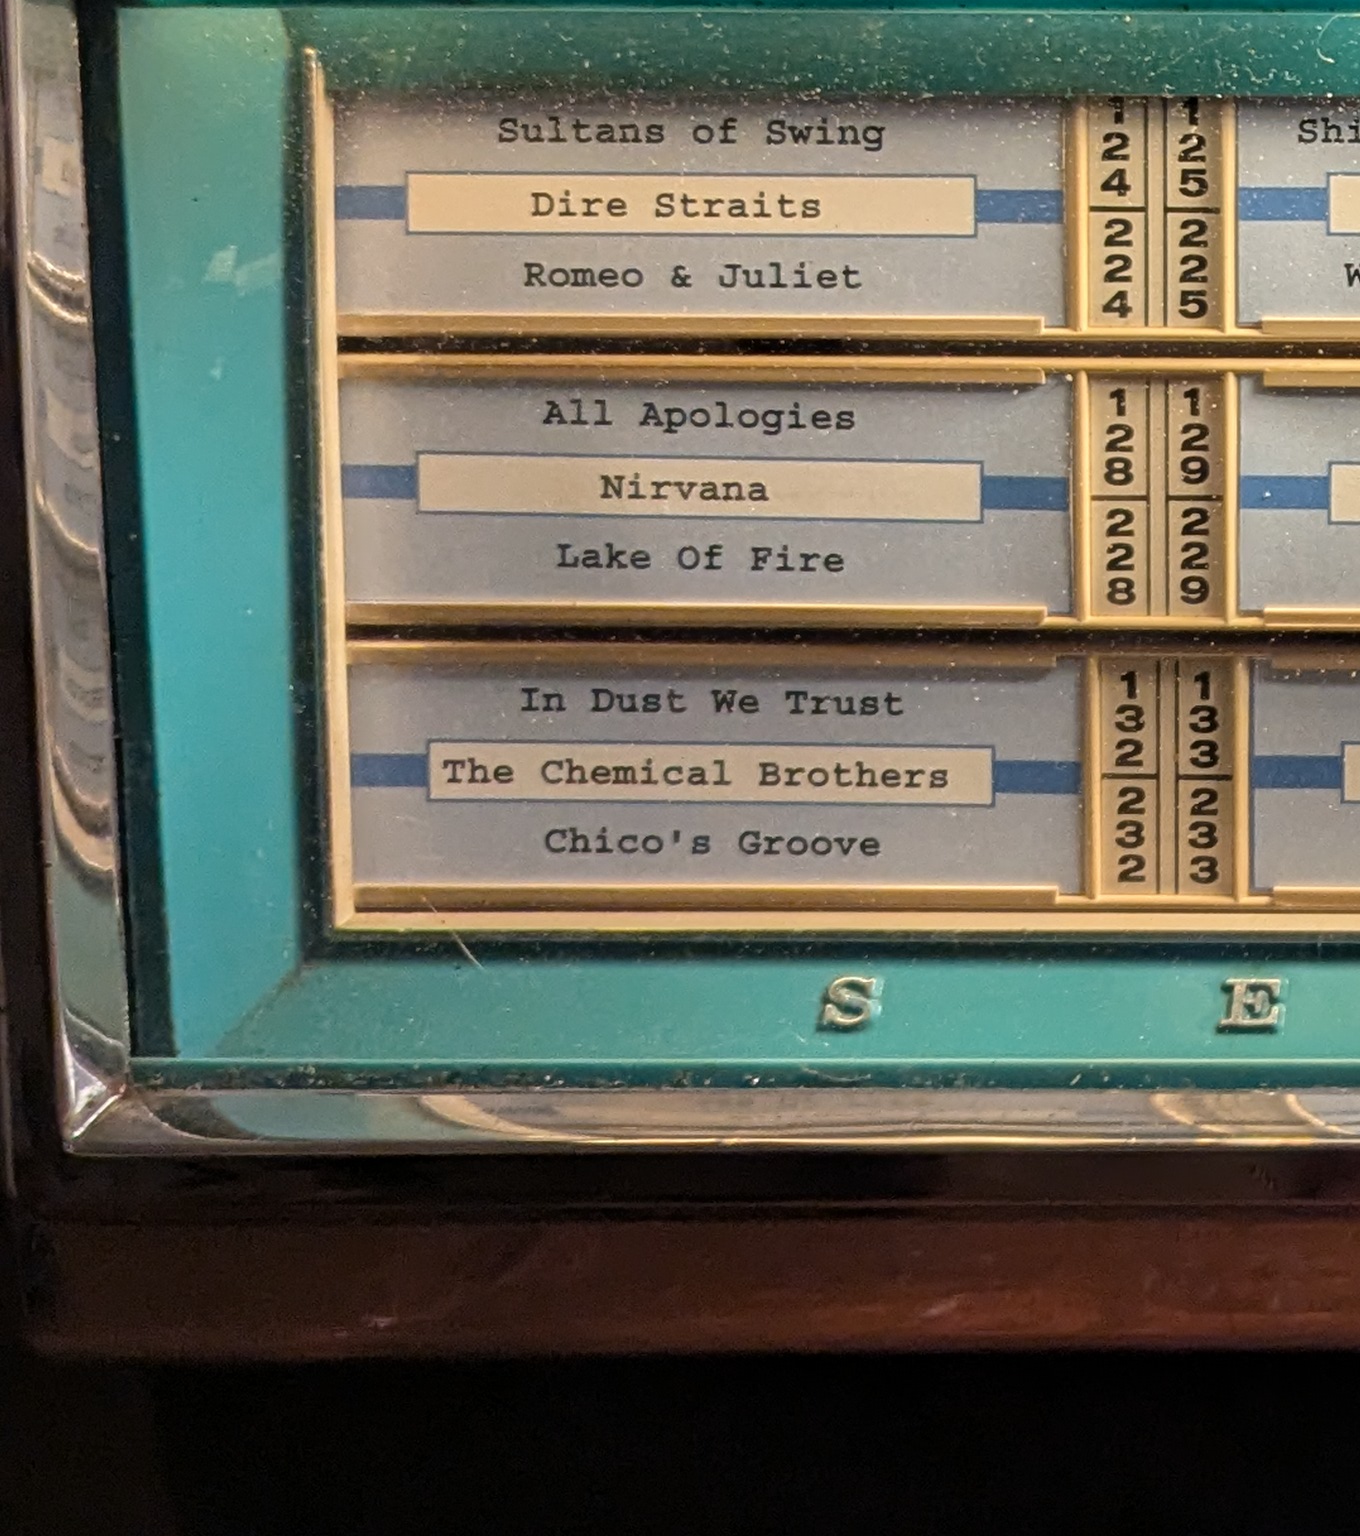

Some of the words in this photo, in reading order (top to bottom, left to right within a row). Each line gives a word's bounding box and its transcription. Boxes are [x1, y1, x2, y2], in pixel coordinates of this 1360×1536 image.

[498, 116, 665, 144] Sultans
[692, 117, 738, 145] of
[765, 120, 886, 152] Swing
[530, 192, 628, 217] Dire
[654, 192, 821, 219] Straits
[523, 262, 644, 288] Romeo
[670, 264, 692, 288] &
[718, 261, 862, 290] Juliet
[542, 399, 613, 426] All
[638, 401, 855, 436] Apologies
[600, 474, 770, 502] Nirvana
[442, 757, 514, 784] The
[540, 758, 732, 786] Chemical
[758, 760, 949, 789] Brothers
[544, 827, 711, 855] Chico's
[738, 830, 881, 857] Groove
